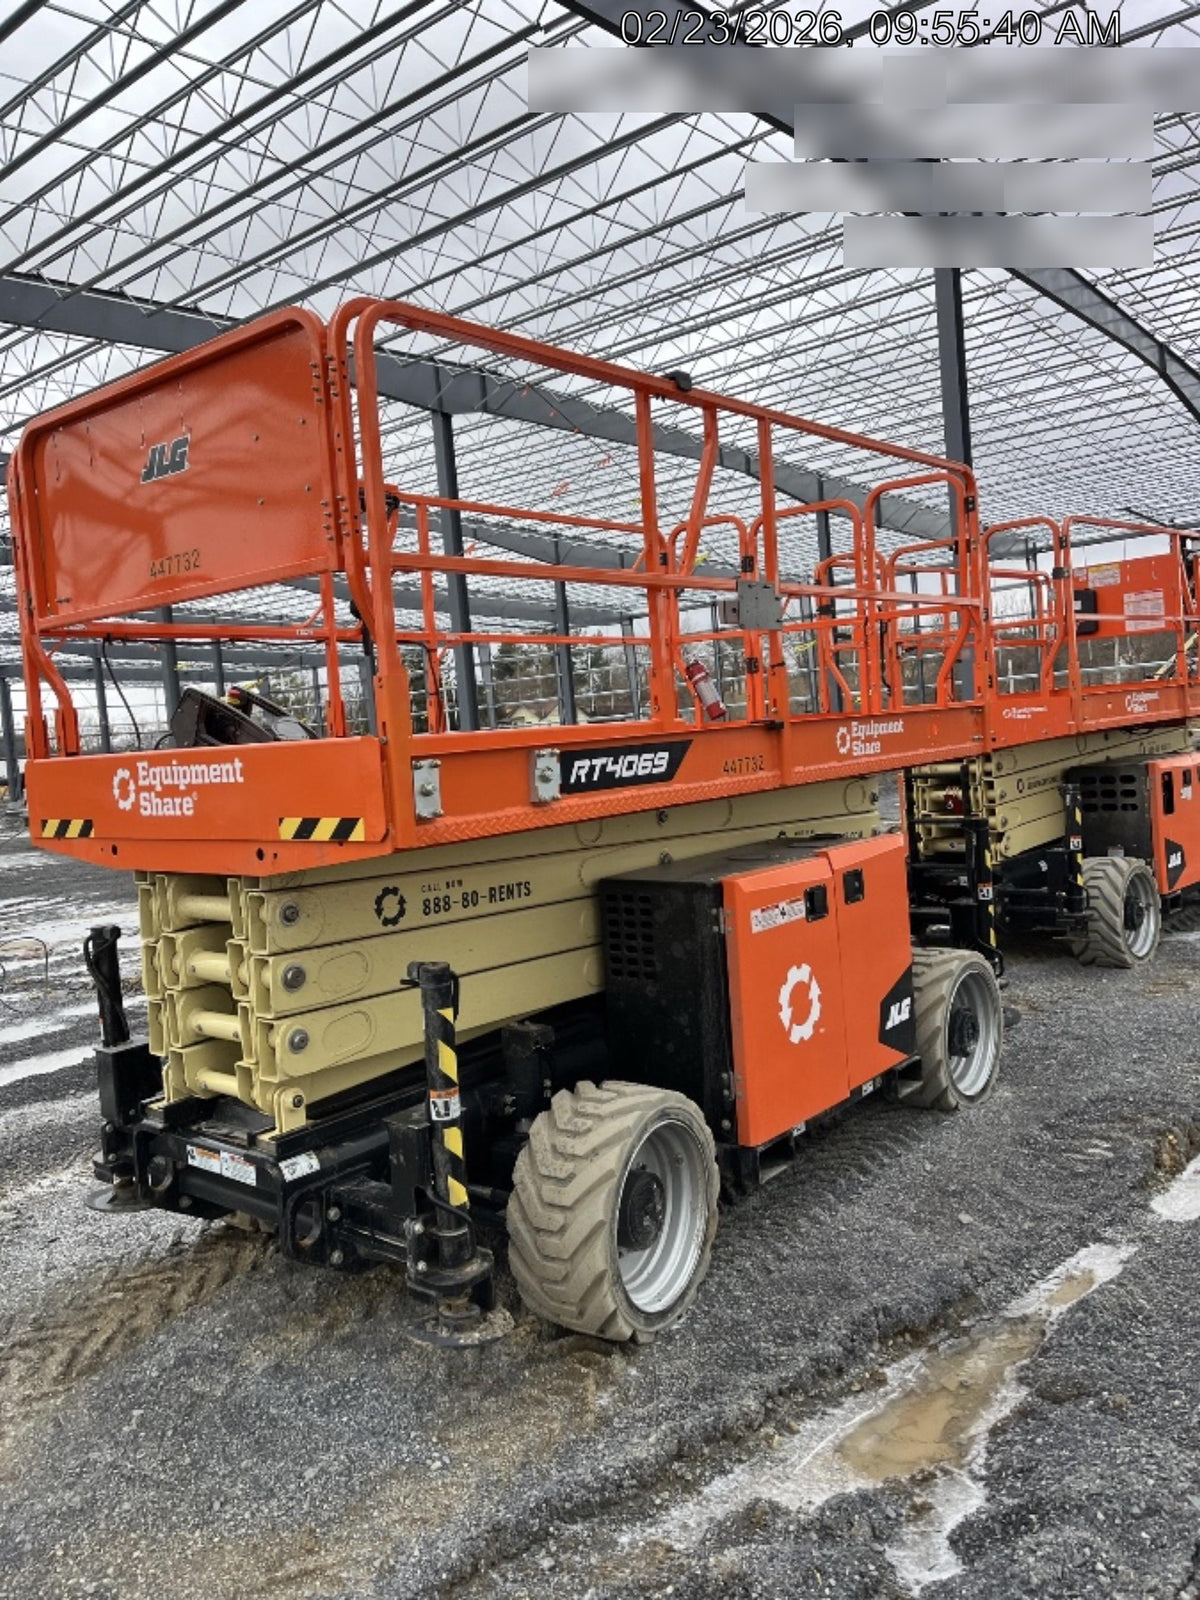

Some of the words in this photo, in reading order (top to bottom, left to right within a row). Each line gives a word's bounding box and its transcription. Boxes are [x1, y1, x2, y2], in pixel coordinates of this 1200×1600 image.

[140, 433, 191, 484] JLG
[150, 548, 201, 578] 447732
[851, 718, 904, 740] Equipment
[722, 754, 765, 775] 447732
[852, 740, 881, 756] Share
[136, 757, 244, 790] Equipment
[570, 750, 669, 785] RT4069
[422, 881, 532, 916] 888-80-RENTS
[884, 996, 912, 1030] JLG
